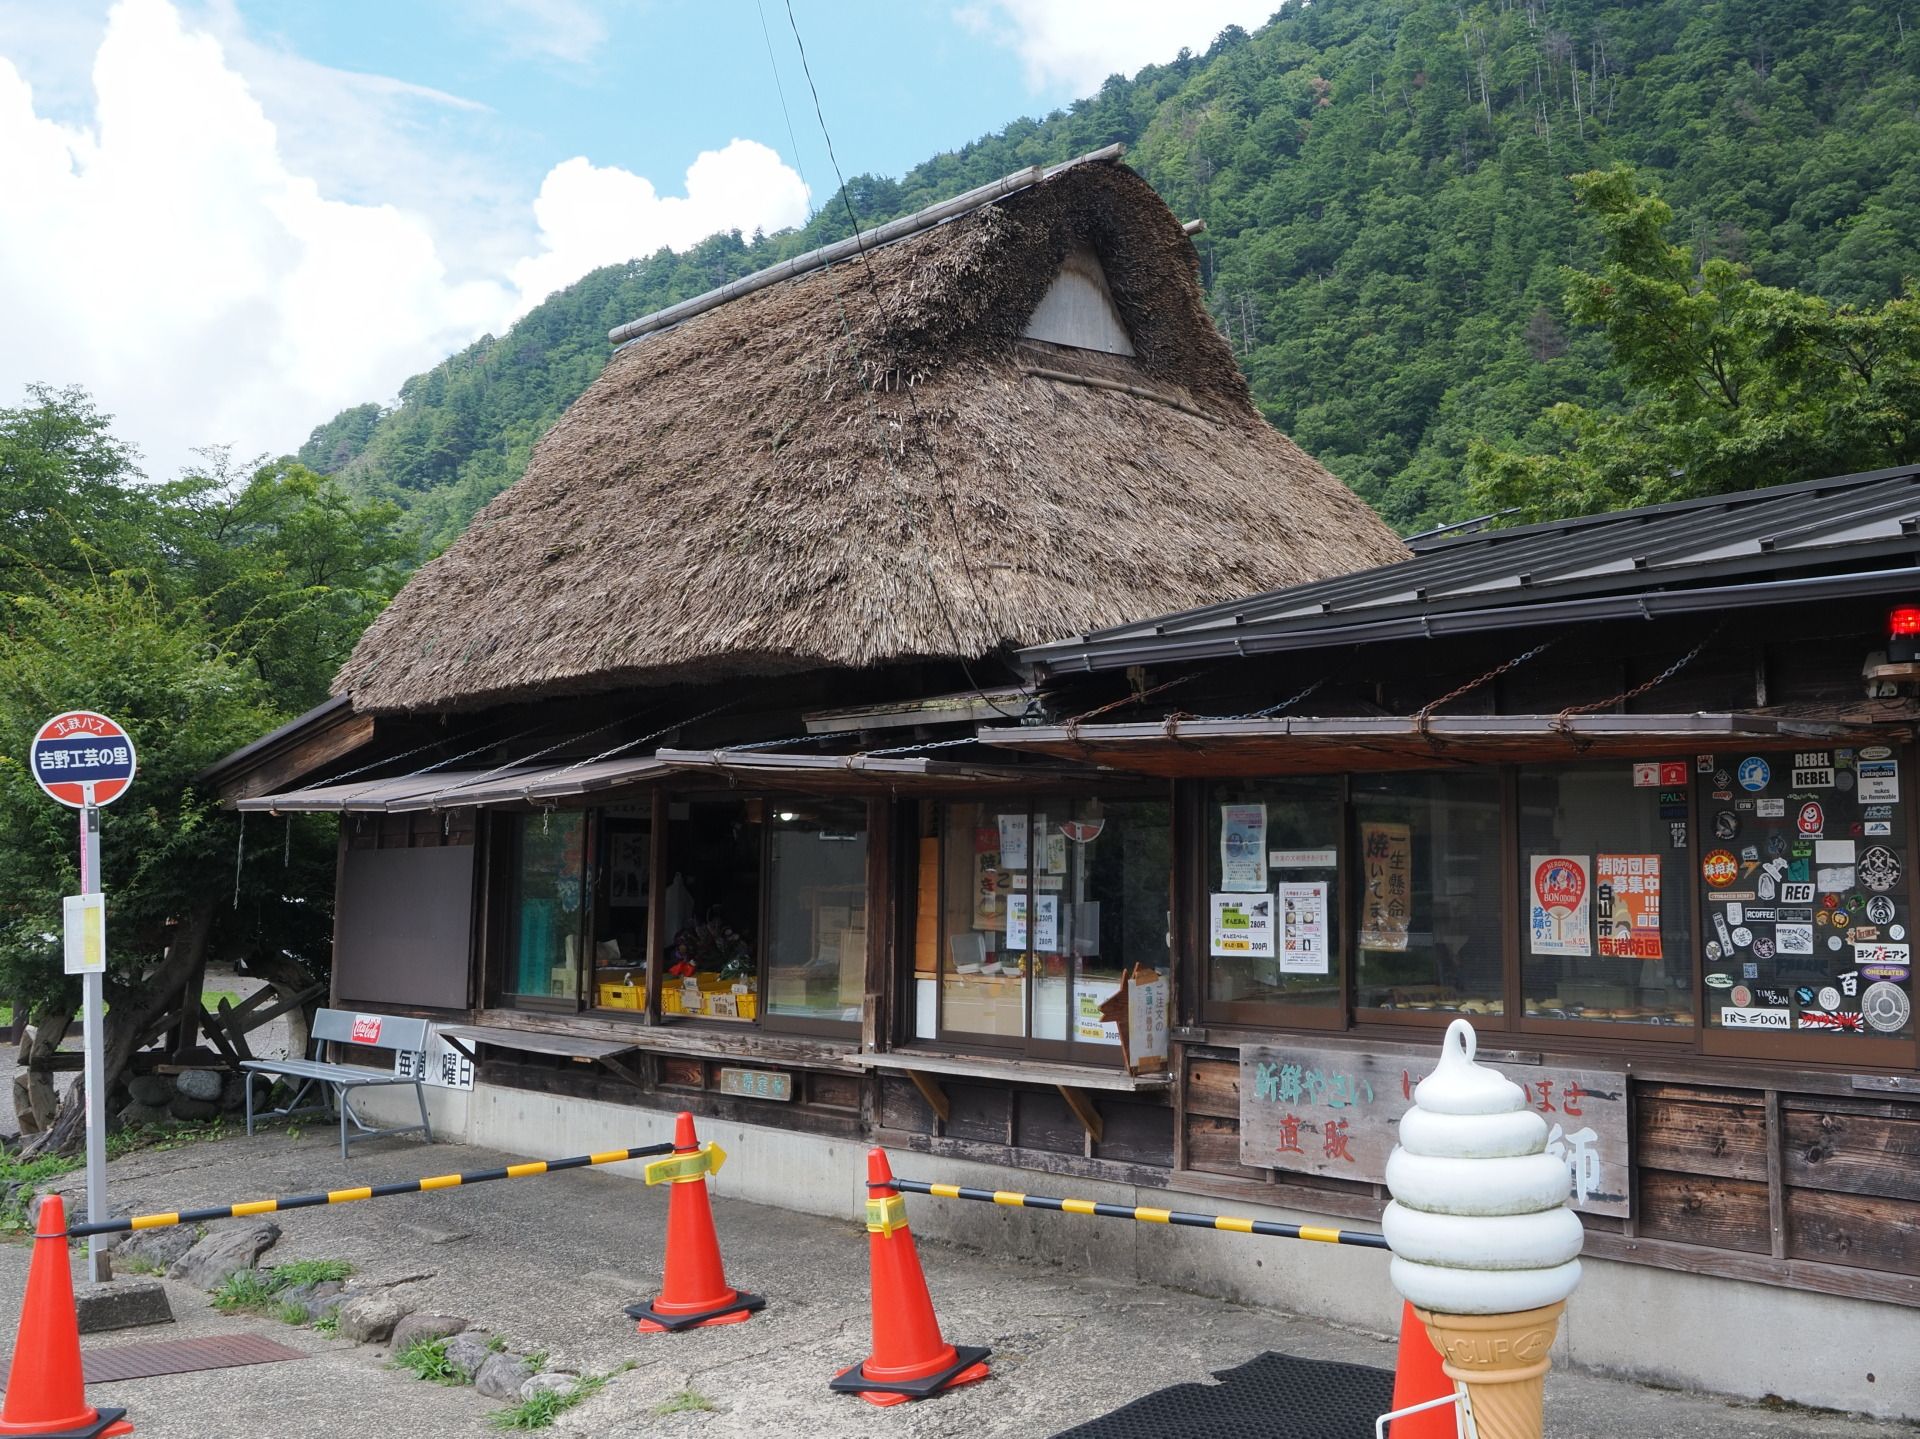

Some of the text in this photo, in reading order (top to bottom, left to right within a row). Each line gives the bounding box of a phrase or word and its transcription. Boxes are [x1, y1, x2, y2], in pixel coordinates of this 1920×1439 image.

[54, 717, 106, 736] 北鉄バス
[38, 746, 129, 770] 吉野工芸の里
[1795, 753, 1830, 767] REBEL
[1796, 771, 1830, 785] REBEL
[1861, 770, 1894, 778] patagonia
[1598, 857, 1660, 876] 消防団員
[1388, 837, 1406, 918] 一生懸命
[1613, 876, 1660, 894] 募集中
[1544, 892, 1560, 902] BON
[1785, 886, 1810, 900] REG
[1598, 884, 1613, 936] 白山市
[1747, 911, 1774, 919] RCOFFEE
[1251, 942, 1267, 951] 300円
[1598, 937, 1662, 957] 南消防団
[1756, 989, 1776, 997] TIME
[1768, 996, 1788, 1005] SCAN
[1155, 984, 1164, 1031] ご注文の
[1254, 1063, 1375, 1108] 新鮮やさい
[1276, 1113, 1355, 1163] 直販
